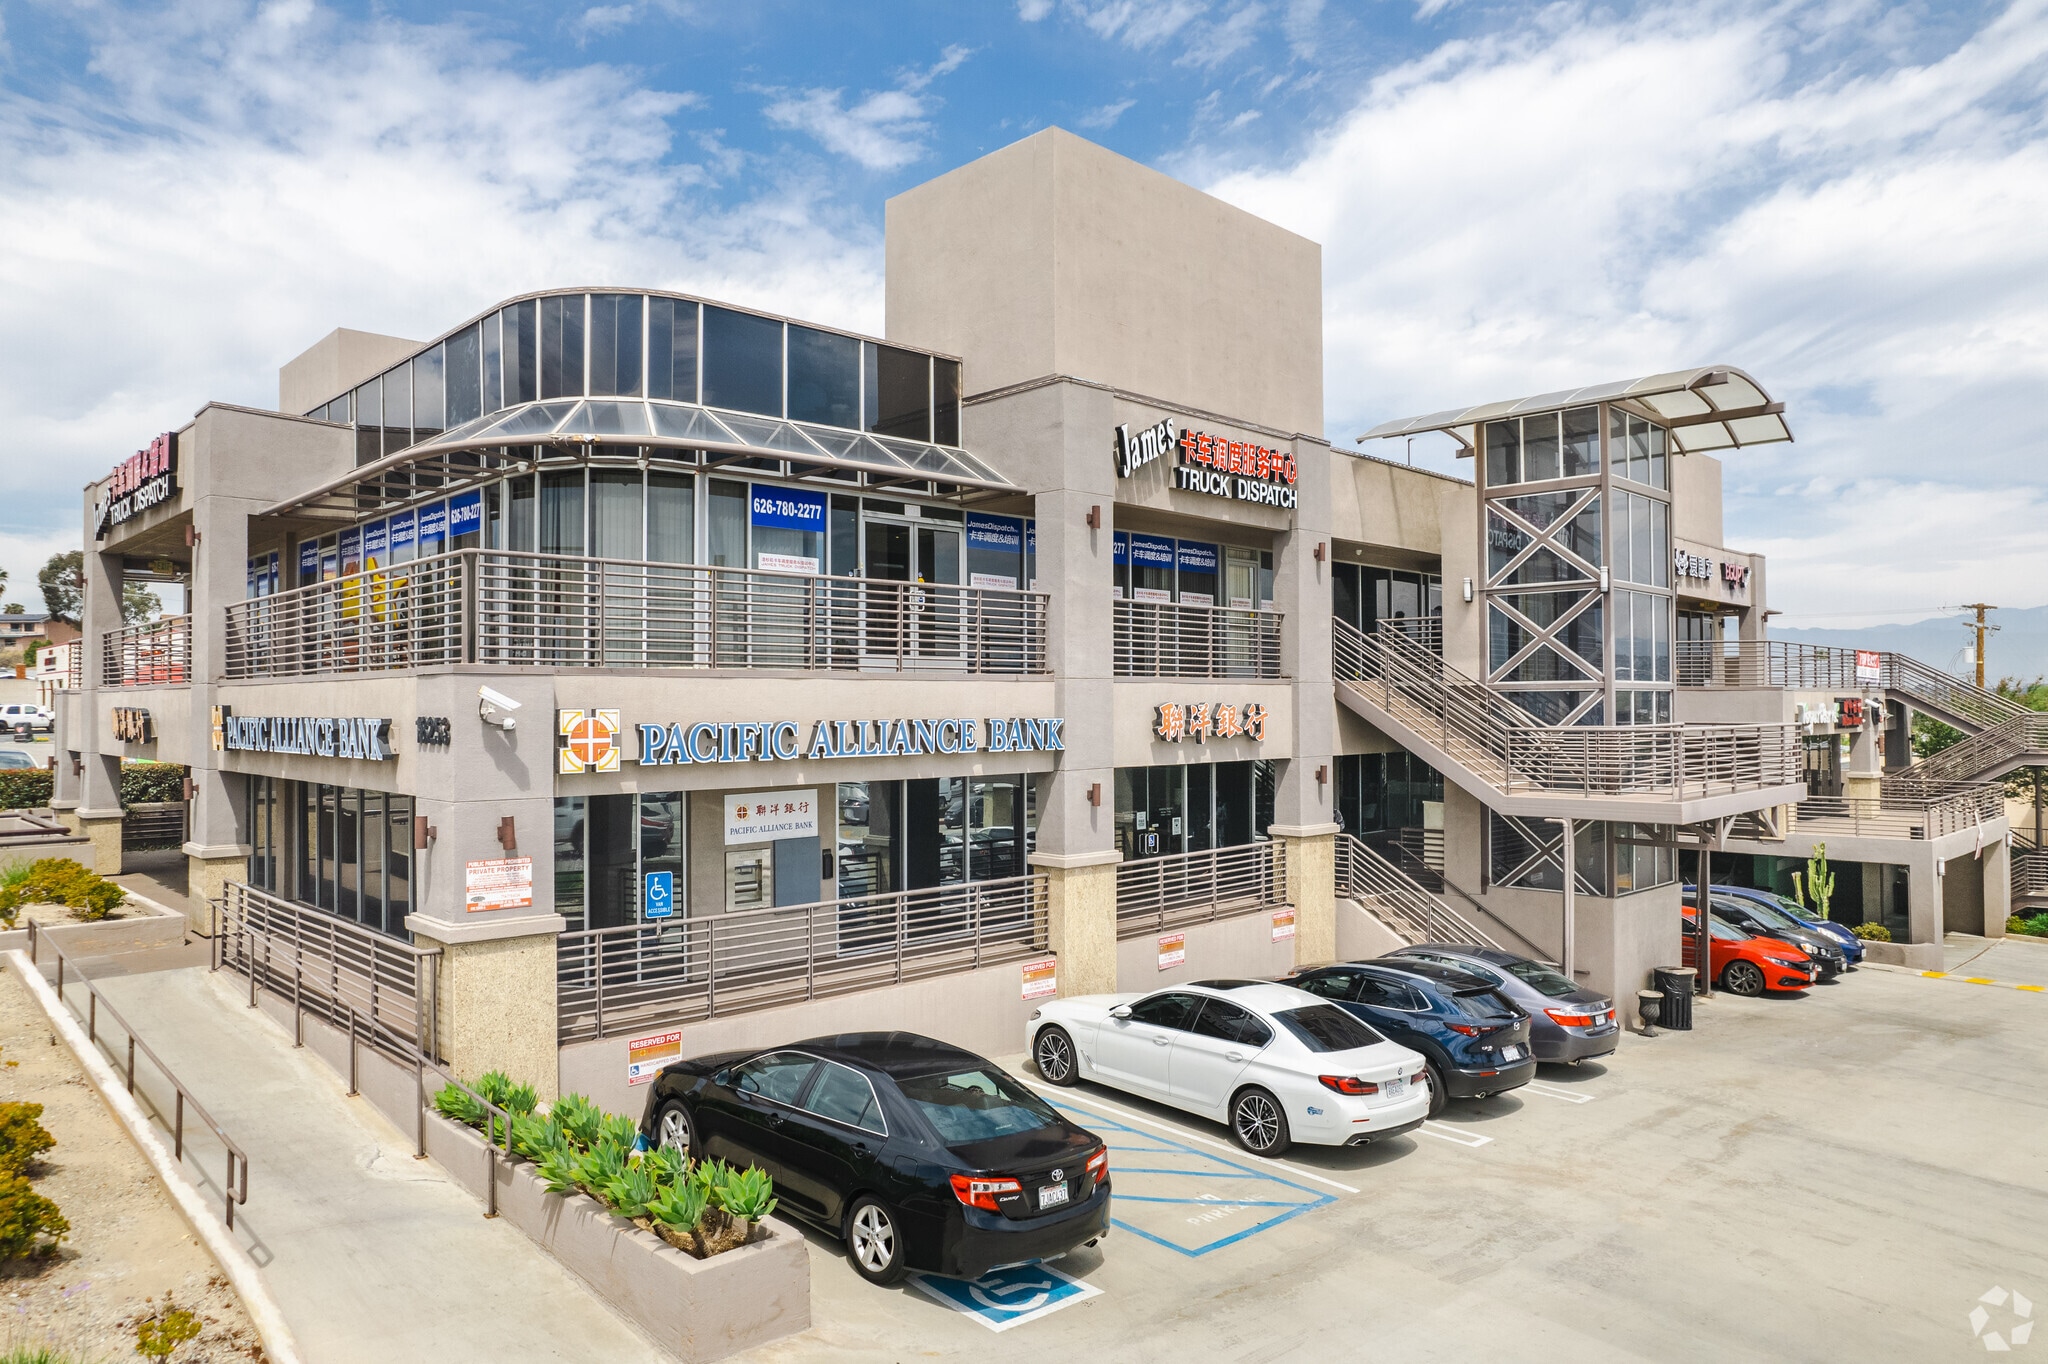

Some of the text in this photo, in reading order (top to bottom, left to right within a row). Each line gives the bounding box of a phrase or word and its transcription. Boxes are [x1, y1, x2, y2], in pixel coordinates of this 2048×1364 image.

[1120, 417, 1176, 478] James
[1179, 428, 1298, 485] 卡车调度服务中心
[110, 474, 169, 525] TRUCK DISPATCH
[753, 497, 822, 520] 626-780-2277
[1179, 467, 1298, 510] TRUCK DISPATCH
[226, 716, 384, 761] PACIFIC ALLIANCE BANK
[639, 718, 1065, 766] PACIFIC ALLIANCE BANK
[1158, 702, 1269, 744] 聯洋銀行
[730, 821, 813, 835] PACIFIC ALLIANCE BANK
[756, 802, 810, 817] 聯洋銀行
[497, 865, 530, 873] PROPERTY
[630, 1033, 680, 1049] RESERVED FOR
